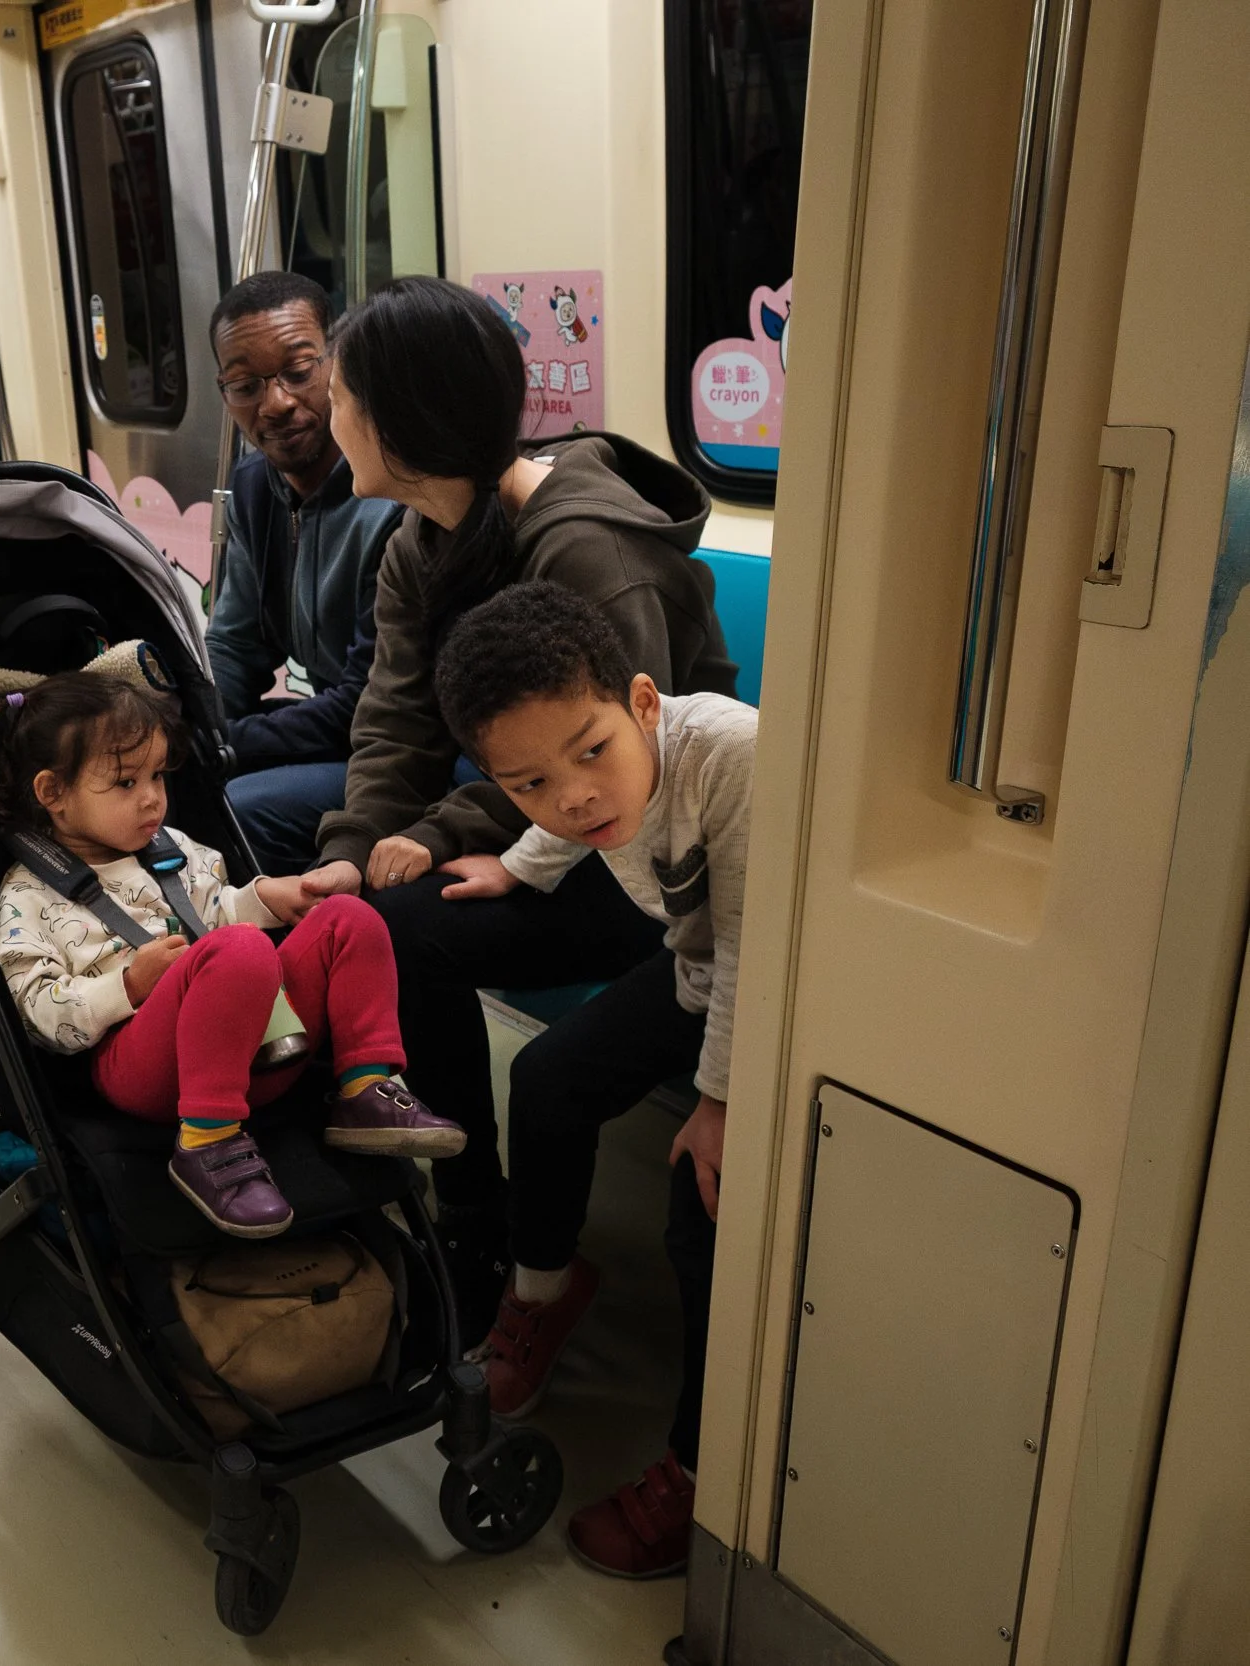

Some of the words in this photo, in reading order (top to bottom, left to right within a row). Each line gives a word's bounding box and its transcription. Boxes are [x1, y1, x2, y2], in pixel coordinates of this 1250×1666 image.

[526, 360, 591, 395] 友善區
[710, 388, 760, 406] crayon
[543, 400, 572, 414] AREA
